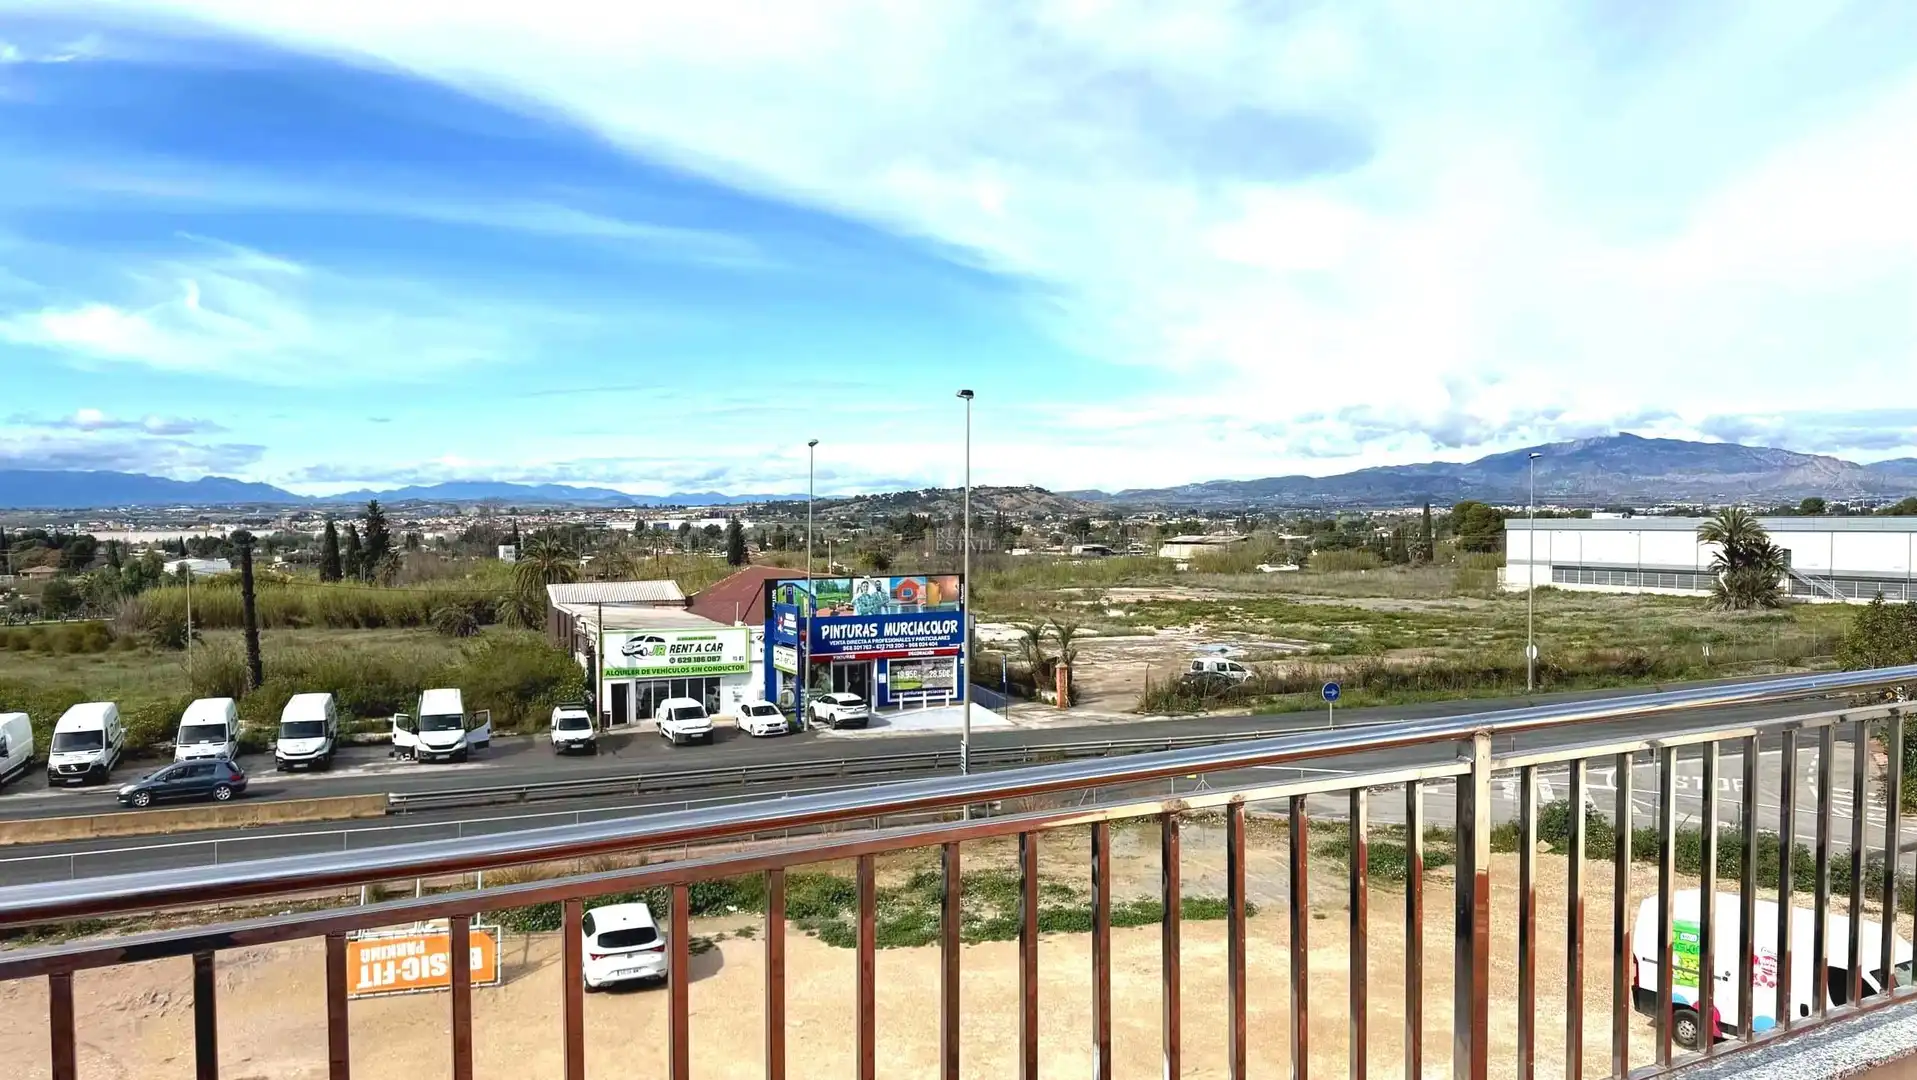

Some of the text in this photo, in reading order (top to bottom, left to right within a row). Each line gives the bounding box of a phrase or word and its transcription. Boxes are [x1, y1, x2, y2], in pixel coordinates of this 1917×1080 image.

[820, 619, 958, 640] PINTURAS MURCIACOLOR
[648, 645, 667, 656] JR
[669, 642, 724, 654] RENT A CAR
[606, 669, 640, 677] ALQUILER
[652, 666, 690, 674] VEHÍCULOS
[360, 939, 425, 964] PARKING
[356, 947, 483, 989] BSIC-FIT
